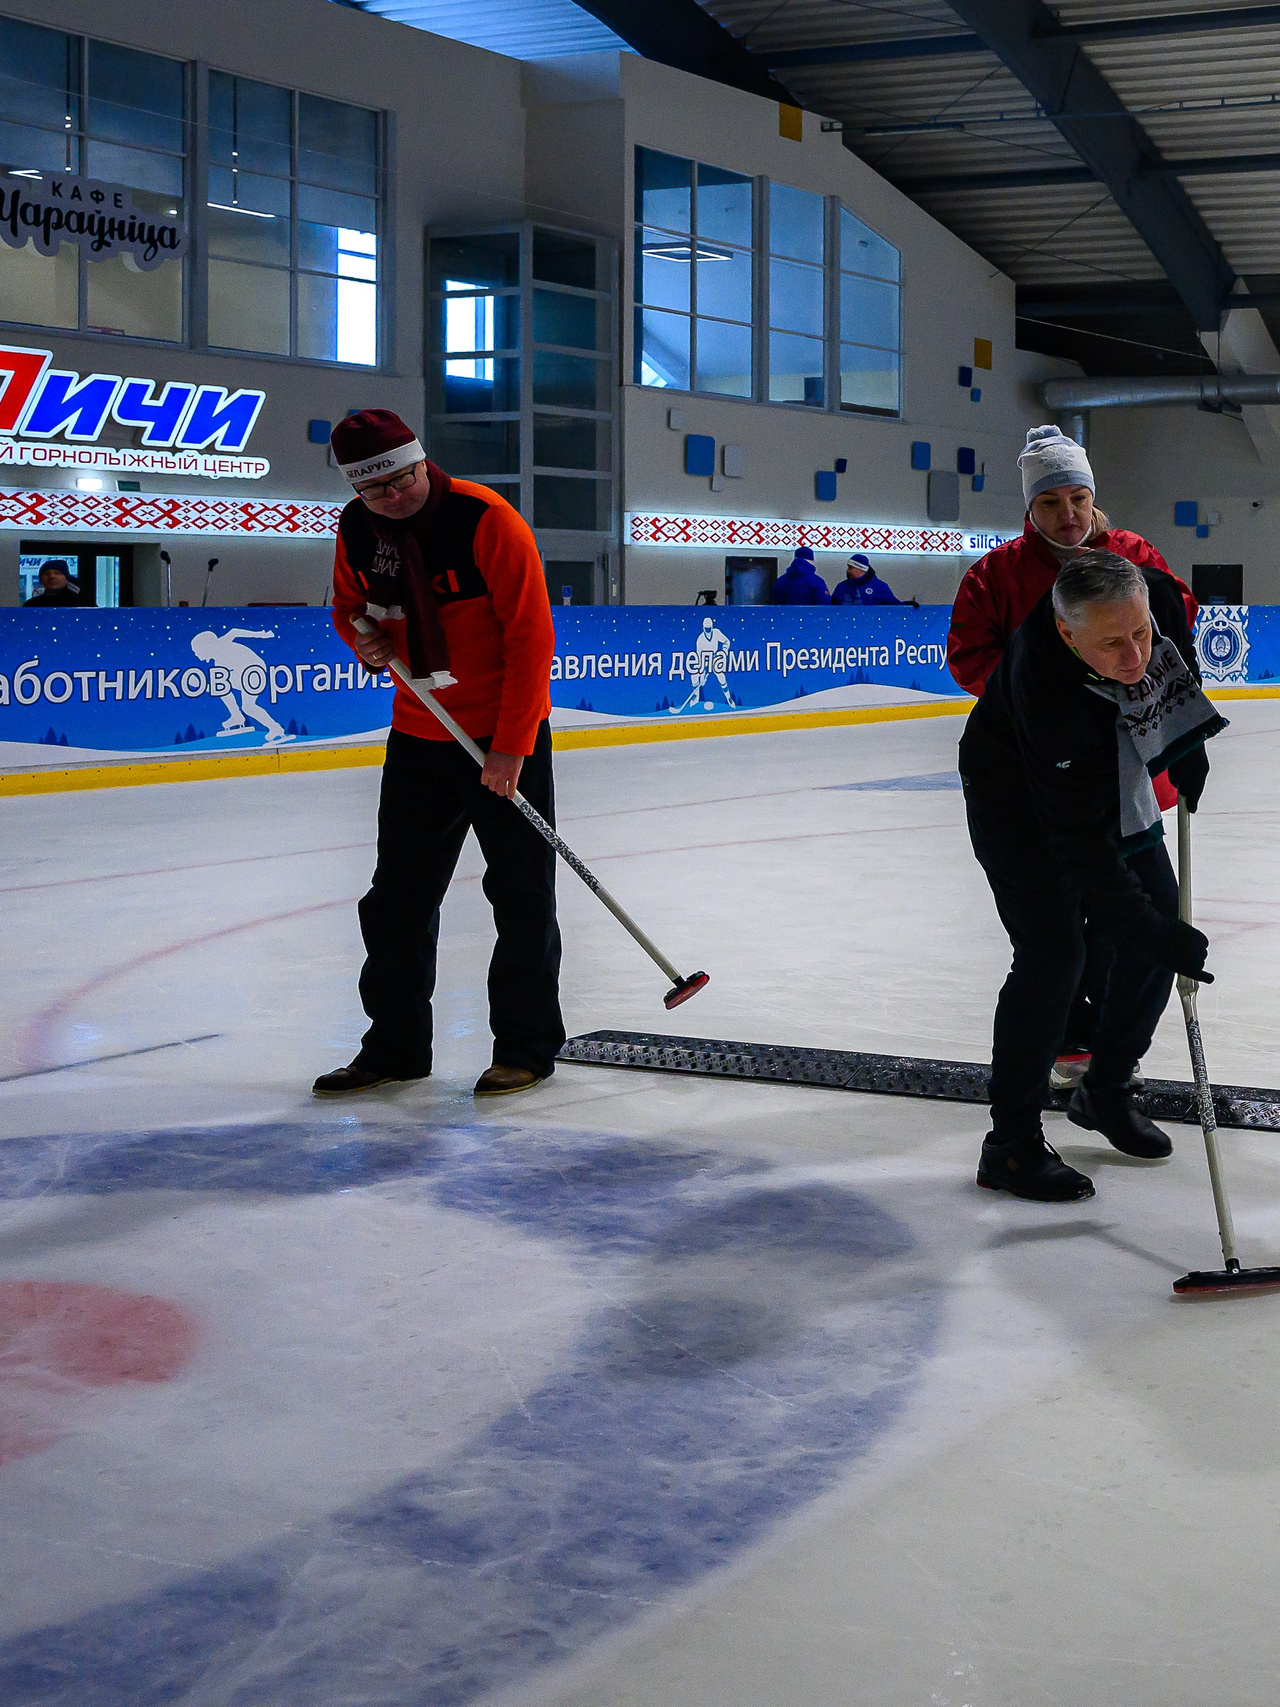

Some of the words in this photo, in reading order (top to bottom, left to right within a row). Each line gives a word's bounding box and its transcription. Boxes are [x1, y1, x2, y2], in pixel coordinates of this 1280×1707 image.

[51, 181, 123, 208] КАФЕ
[20, 446, 198, 471] ГОРНОЛЫЖНЫЙ
[204, 459, 266, 475] ЦЕНТР
[346, 459, 395, 478] БЕЛАРУСЬ
[668, 649, 760, 681] делами
[766, 642, 889, 677] Президента
